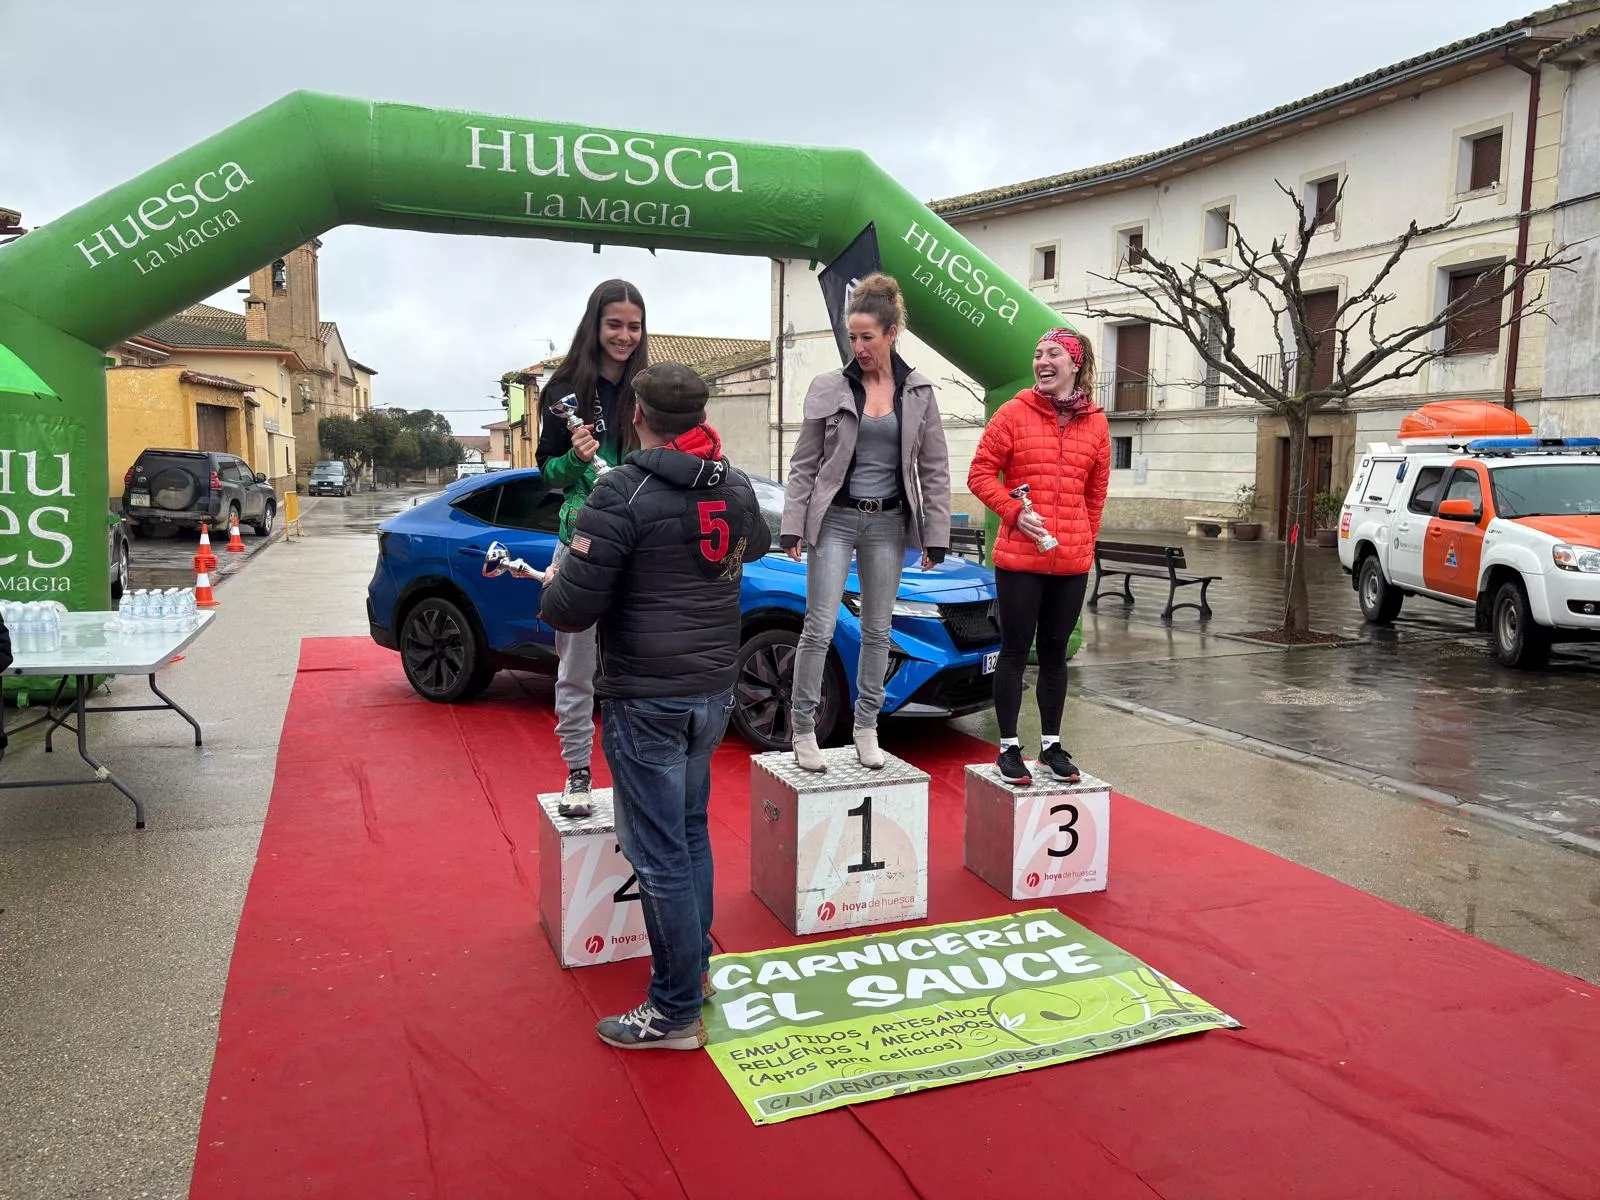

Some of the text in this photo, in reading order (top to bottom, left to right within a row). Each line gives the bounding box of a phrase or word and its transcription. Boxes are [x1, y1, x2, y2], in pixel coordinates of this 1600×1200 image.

[466, 126, 743, 193] Huesca
[73, 160, 255, 269] Huesca
[523, 191, 565, 218] La
[132, 249, 166, 275] La
[901, 220, 1020, 326] Huesca
[911, 264, 934, 289] La
[697, 500, 730, 562] 5
[847, 796, 885, 874] 1
[1047, 804, 1079, 858] 3
[1044, 873, 1062, 882] hoya
[1072, 870, 1097, 878] huesca
[842, 901, 867, 912] hoya
[868, 898, 880, 908] de
[881, 895, 915, 906] huesca
[611, 934, 637, 945] hoya
[711, 920, 1067, 991] CARNICERÍA
[722, 942, 1102, 1031] EL SAUCE
[730, 1028, 862, 1061] EMBUTIDOS
[738, 1044, 852, 1072] RELLENOS
[856, 1039, 870, 1051] Y
[747, 1039, 963, 1087] (Aptos para celíacos)
[769, 1096, 791, 1110] C/
[800, 1071, 910, 1106] VALENCIA
[985, 1046, 1064, 1068] HUESCA
[1111, 1028, 1145, 1043] 974
[1147, 1017, 1181, 1030] 238
